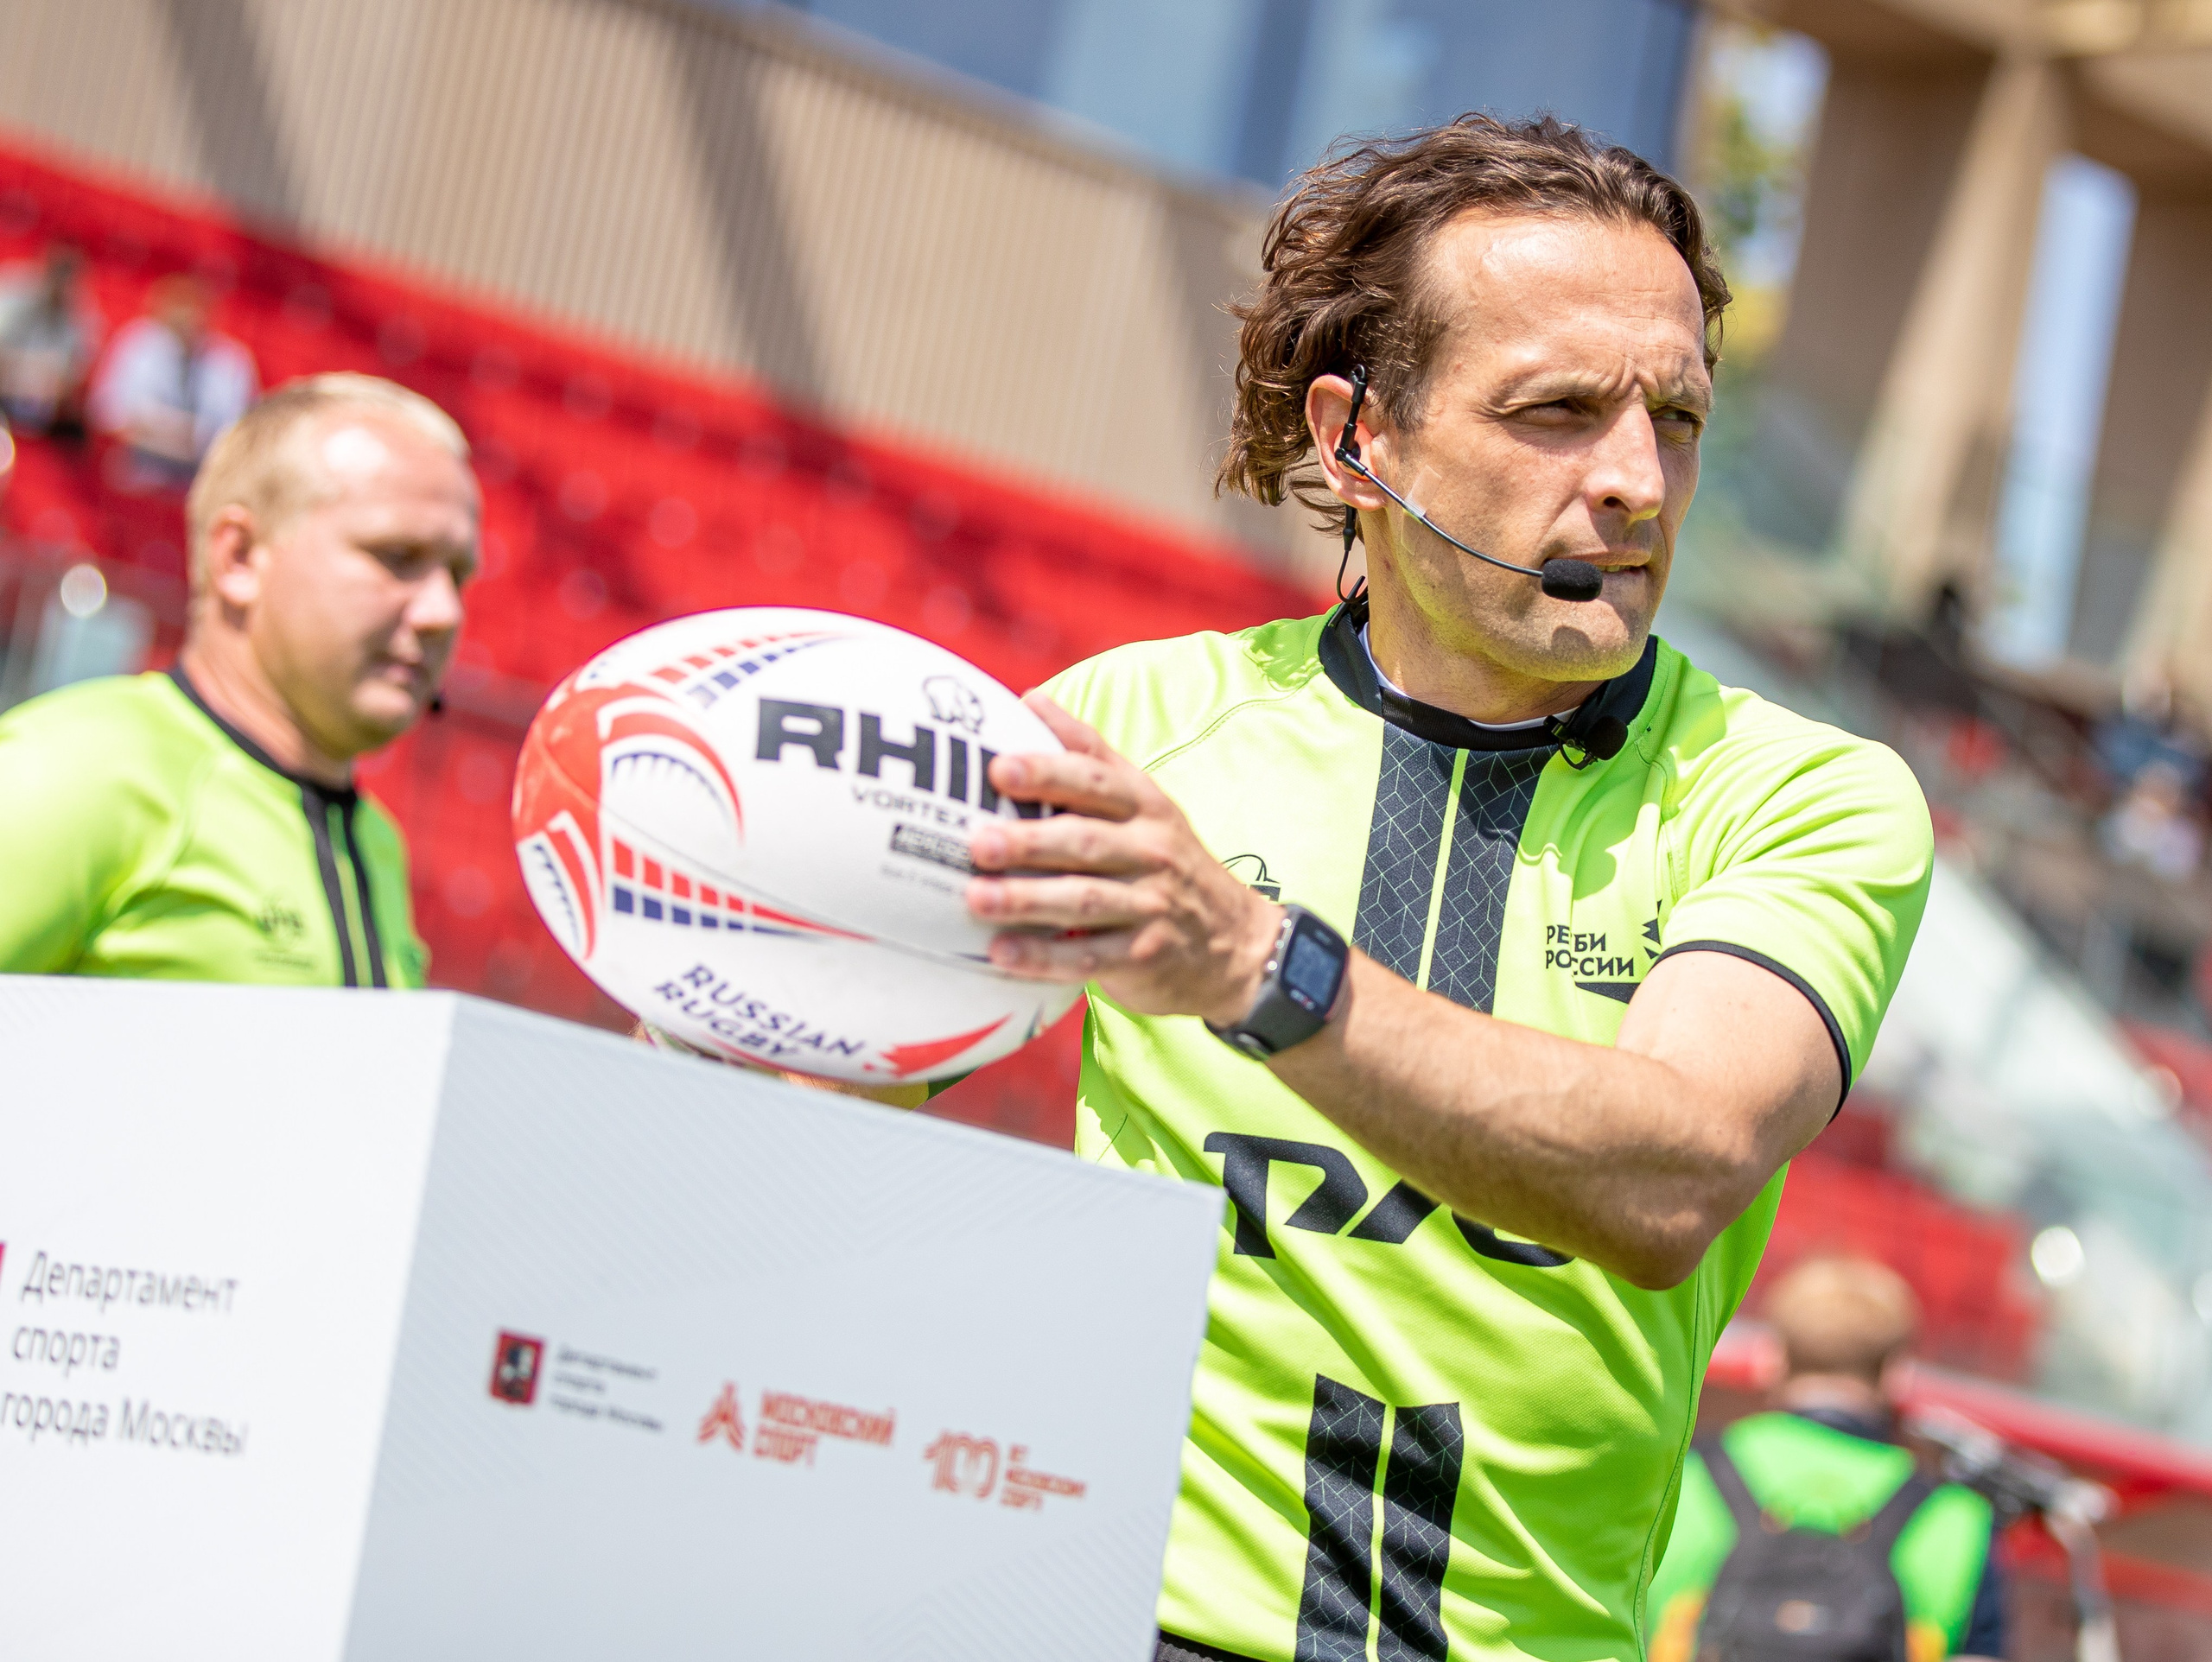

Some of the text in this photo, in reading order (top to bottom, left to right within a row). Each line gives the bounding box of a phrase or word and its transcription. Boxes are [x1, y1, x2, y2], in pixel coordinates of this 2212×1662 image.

[755, 698, 1070, 819] RHI
[1546, 923, 1606, 953] РЕБИ
[653, 980, 799, 1056] RUGBY
[681, 964, 866, 1056] RUSSIAN
[20, 1249, 240, 1314] Департамент
[12, 1325, 121, 1379] спорта
[0, 1392, 249, 1456] города Москвы
[754, 1425, 817, 1468] СПОРТ
